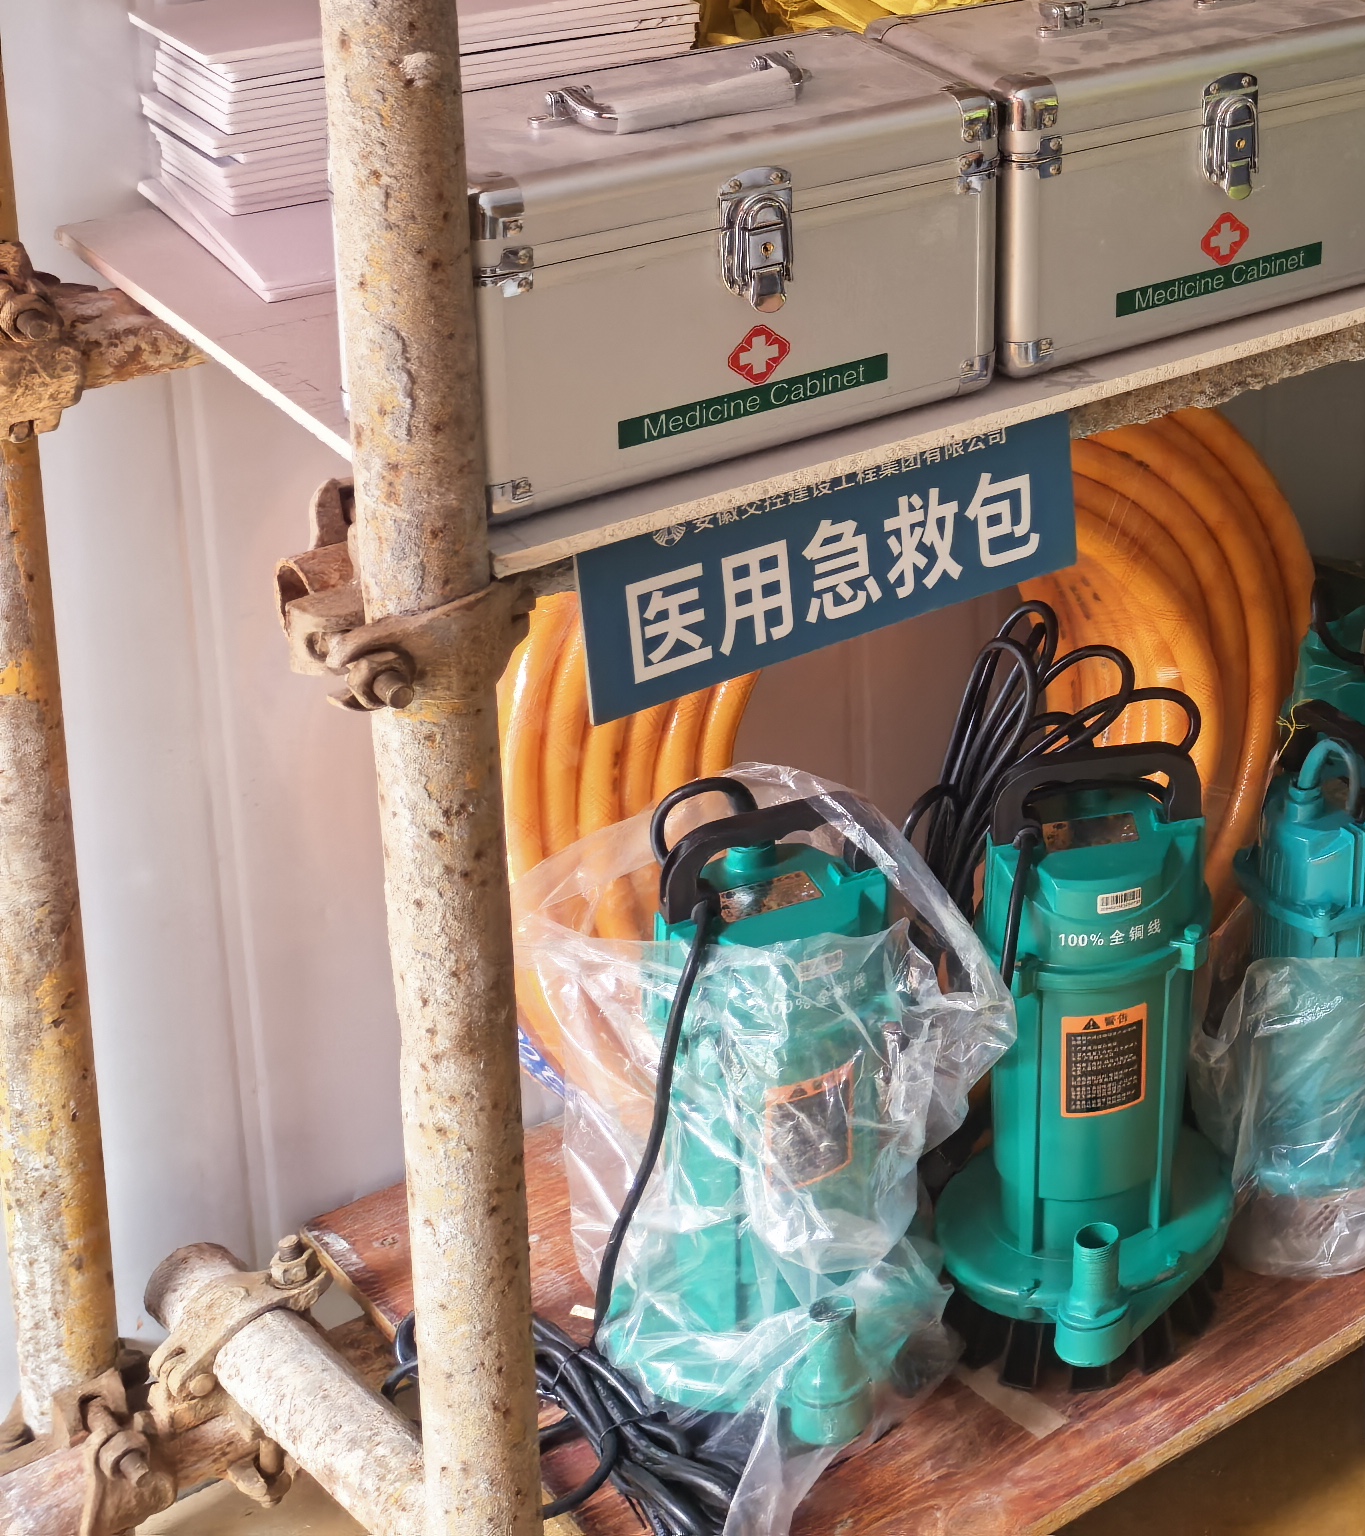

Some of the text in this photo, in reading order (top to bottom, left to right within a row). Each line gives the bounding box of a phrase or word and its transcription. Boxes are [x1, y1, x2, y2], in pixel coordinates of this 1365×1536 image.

[1134, 251, 1305, 311] Medicine Cabinet
[642, 364, 866, 441] Medicine Cabinet
[625, 472, 1041, 685] 医用急救包
[1058, 918, 1161, 948] 100% 全铜线
